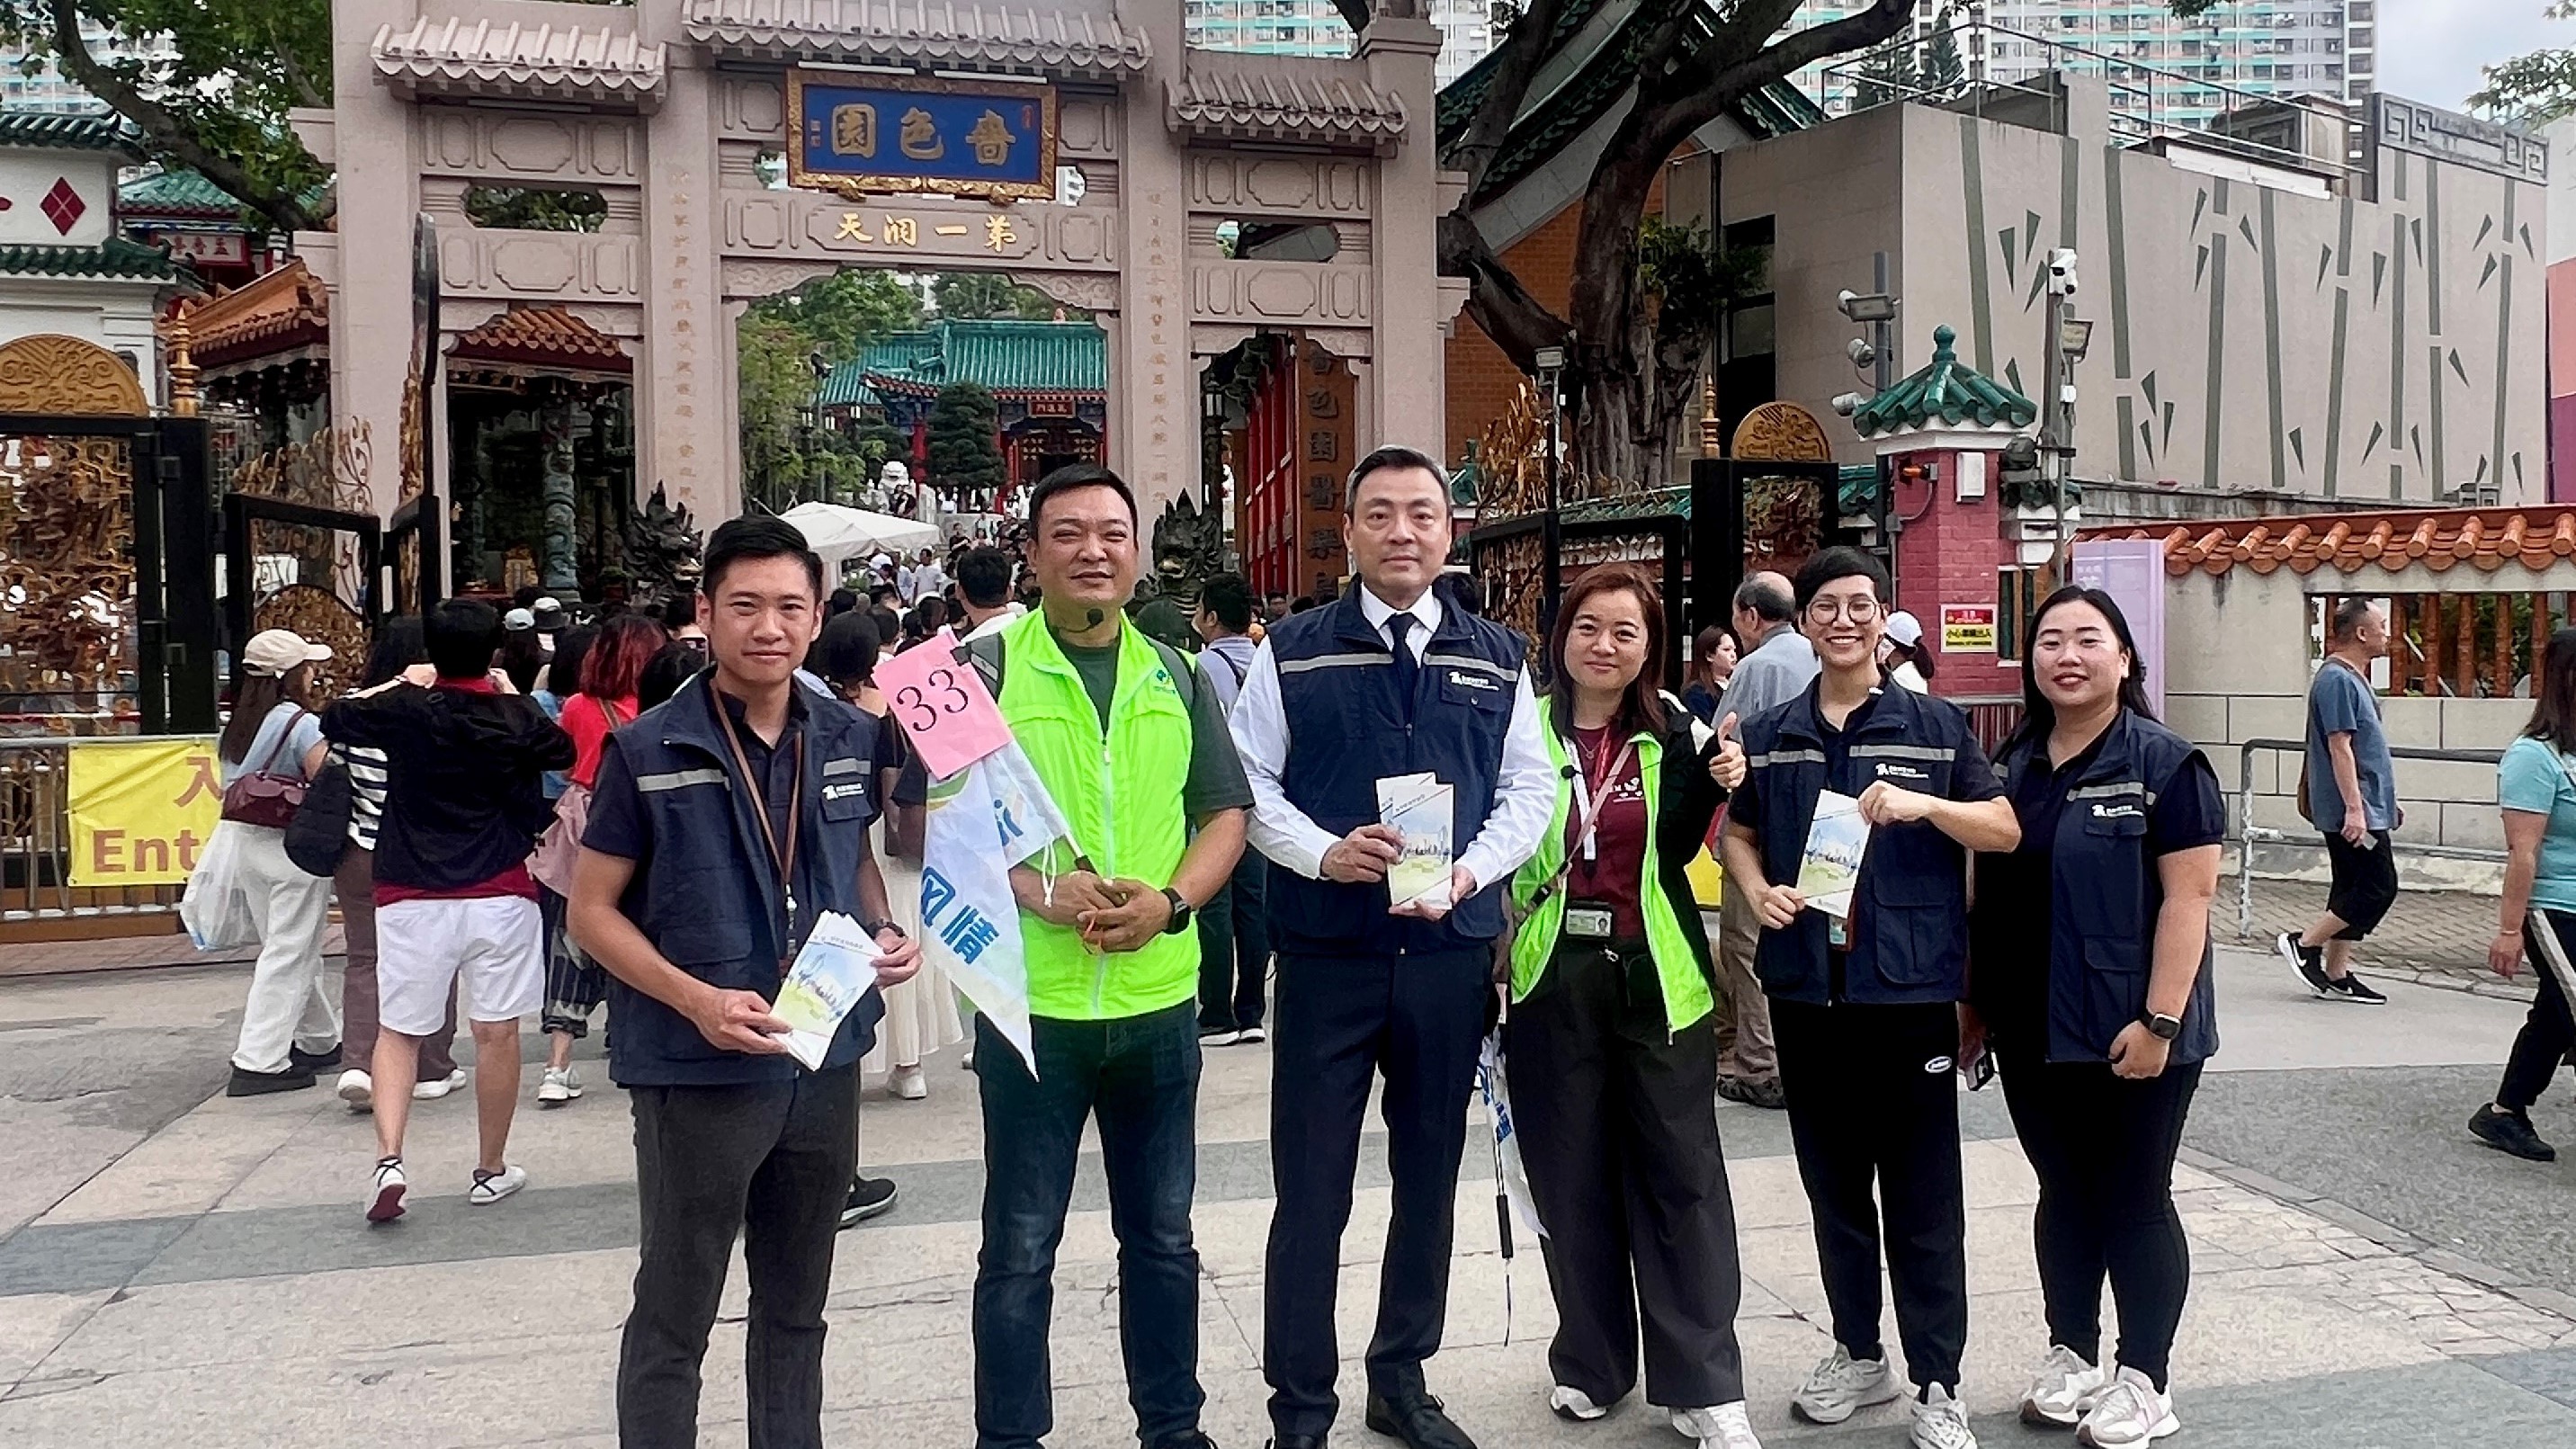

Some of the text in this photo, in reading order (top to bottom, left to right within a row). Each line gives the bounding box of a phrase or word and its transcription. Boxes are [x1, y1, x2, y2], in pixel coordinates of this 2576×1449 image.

[830, 102, 1016, 167] 嗇色園
[896, 669, 969, 732] 33
[93, 828, 212, 873] Ent
